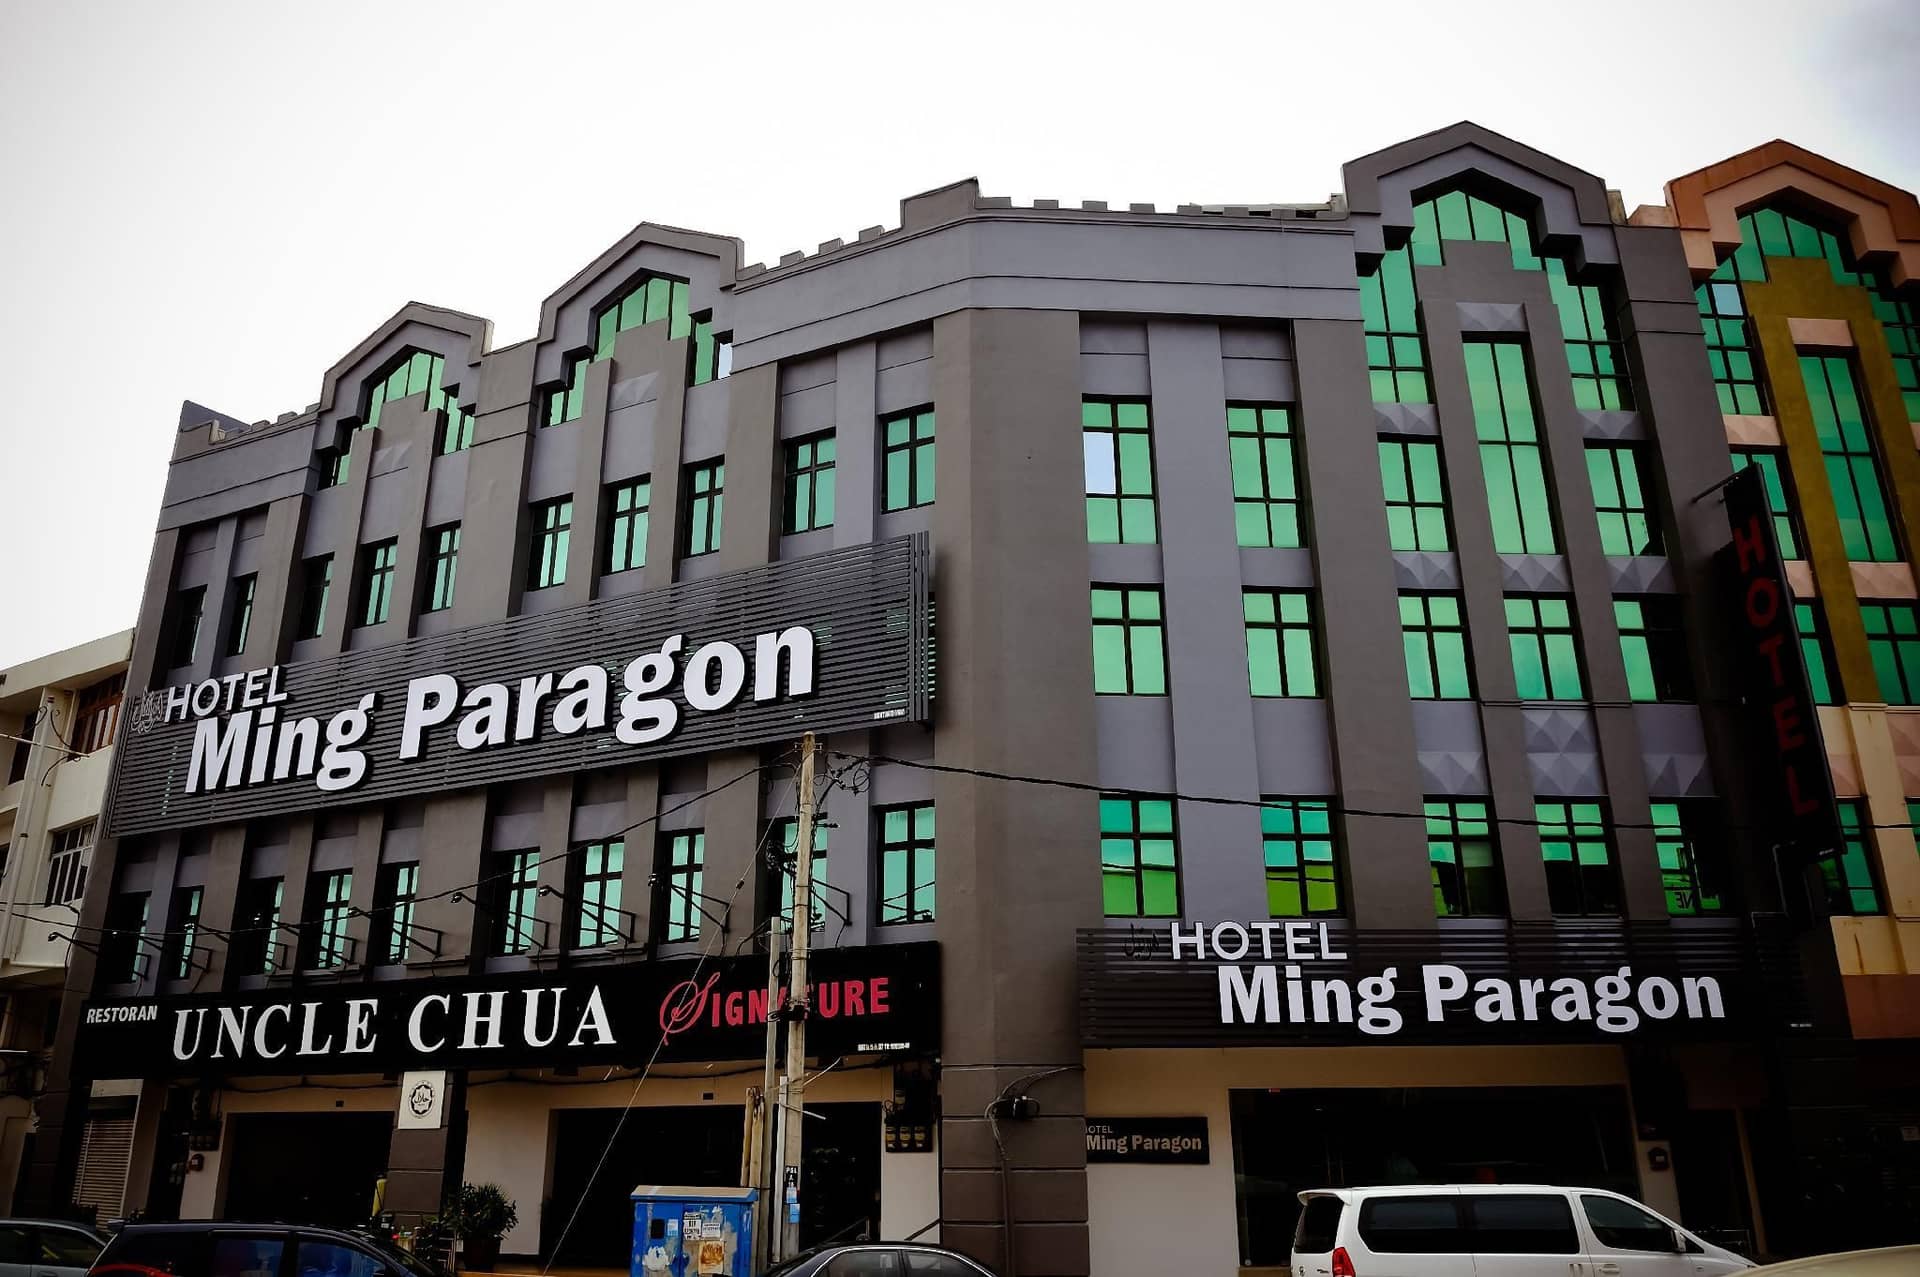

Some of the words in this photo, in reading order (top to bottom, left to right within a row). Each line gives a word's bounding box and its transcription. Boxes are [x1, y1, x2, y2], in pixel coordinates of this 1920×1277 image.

[164, 665, 288, 723] HOTEL
[1733, 514, 1818, 815] HOTEL
[185, 692, 376, 793] Ming
[399, 625, 815, 762] Paragon
[1171, 922, 1348, 960] HOTEL
[86, 1005, 158, 1023] RESTORAN
[172, 999, 378, 1060] UNCLE
[407, 985, 617, 1052] CHUA
[1218, 965, 1403, 1035] Ming
[1422, 965, 1726, 1033] Paragon
[1086, 1135, 1128, 1153] Ming
[1131, 1134, 1202, 1153] Paragon
